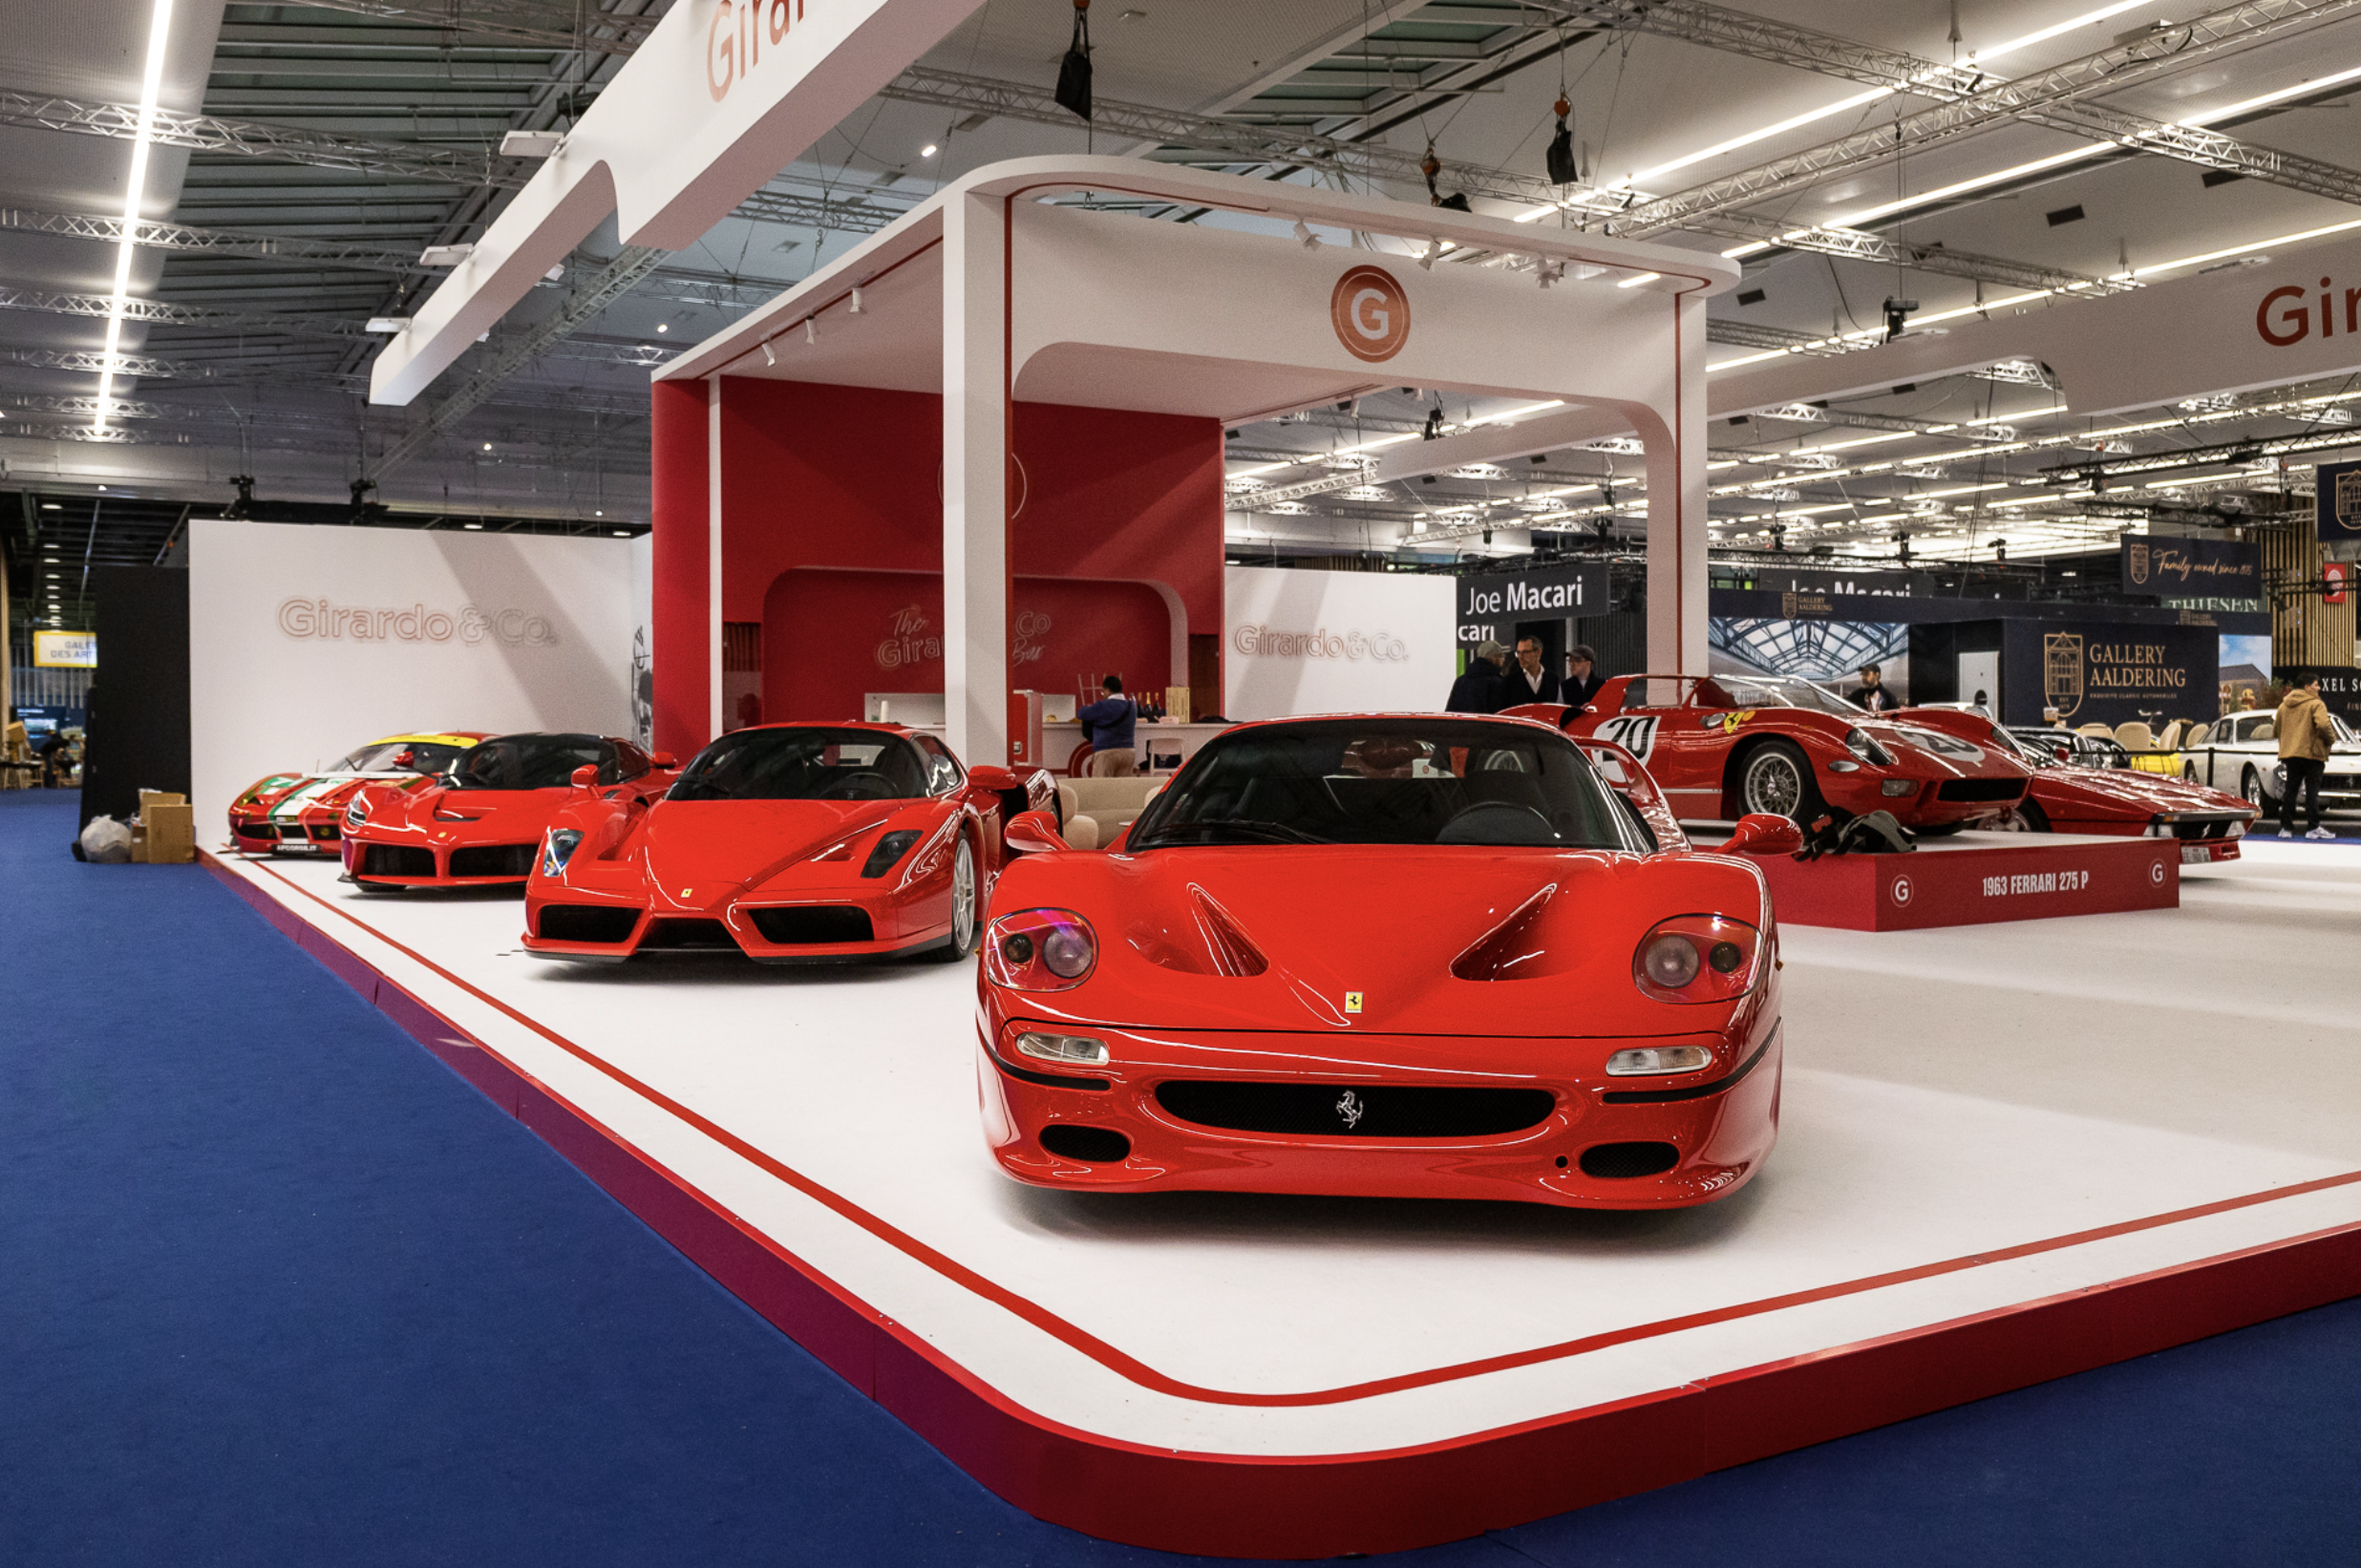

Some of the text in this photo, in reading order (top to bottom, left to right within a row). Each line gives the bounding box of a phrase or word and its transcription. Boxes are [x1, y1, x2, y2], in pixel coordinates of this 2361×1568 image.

[1350, 287, 1390, 341] G
[2152, 548, 2192, 582] Family
[2194, 558, 2219, 576] owned
[2218, 562, 2238, 575] since
[1465, 575, 1583, 616] Joe Macari
[1797, 596, 1826, 604] GALLERY
[888, 604, 929, 638] The
[877, 634, 944, 668] Gira
[2089, 644, 2166, 665] GALLERY
[2089, 667, 2186, 688] AALDERING
[2351, 677, 2361, 692] S
[1982, 870, 2089, 897] 1963 FERRARI 275 P
[2151, 863, 2163, 883] G
[1895, 879, 1909, 901] G
